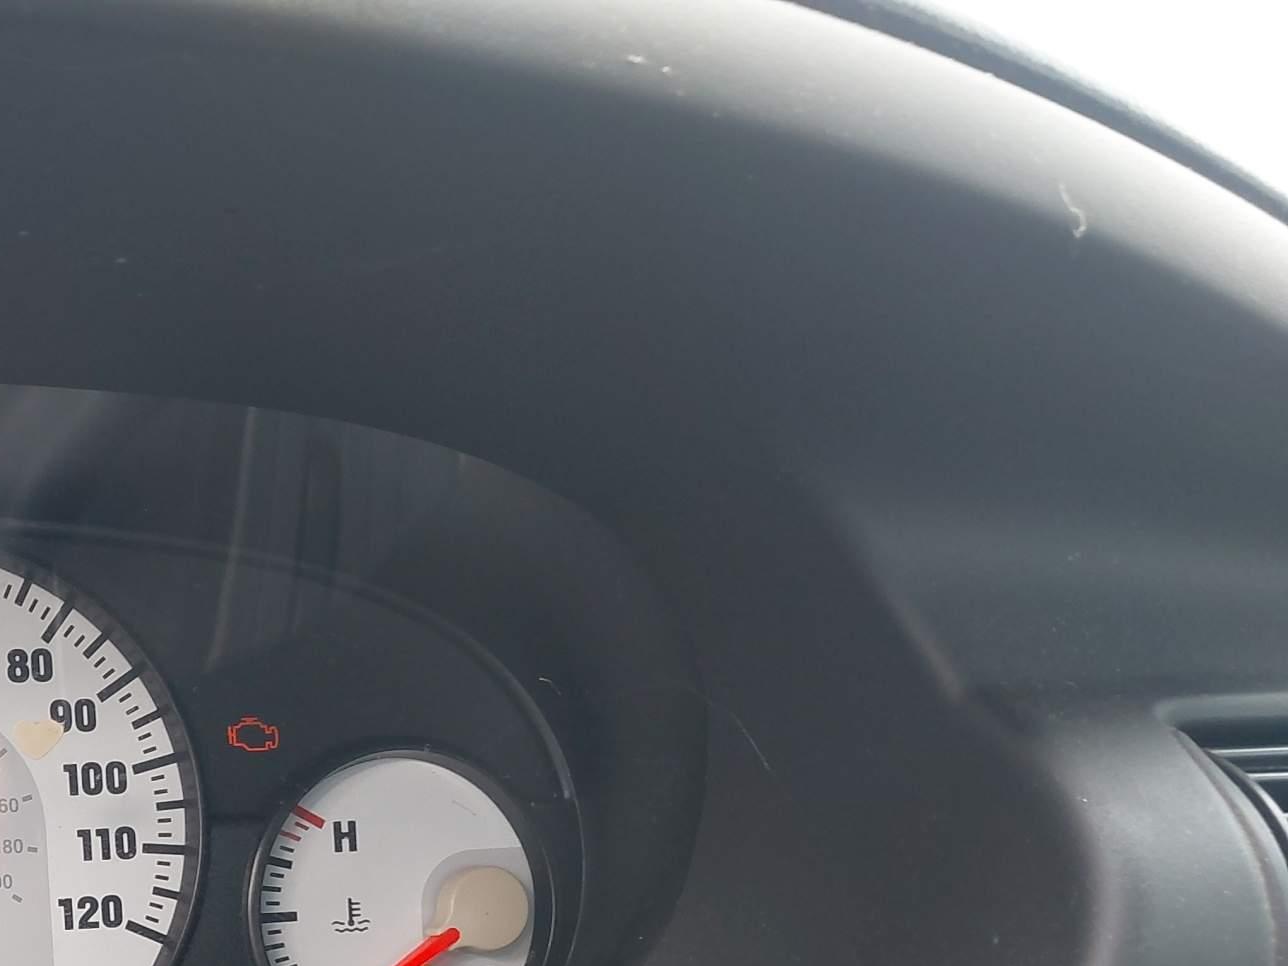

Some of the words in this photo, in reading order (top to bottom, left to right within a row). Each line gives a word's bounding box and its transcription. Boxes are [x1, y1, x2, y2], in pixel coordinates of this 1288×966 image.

[6, 648, 54, 684] 80
[49, 698, 98, 733] 90
[62, 760, 128, 797] 100
[75, 825, 138, 862] 110
[332, 820, 359, 854] H
[56, 894, 125, 932] 120
